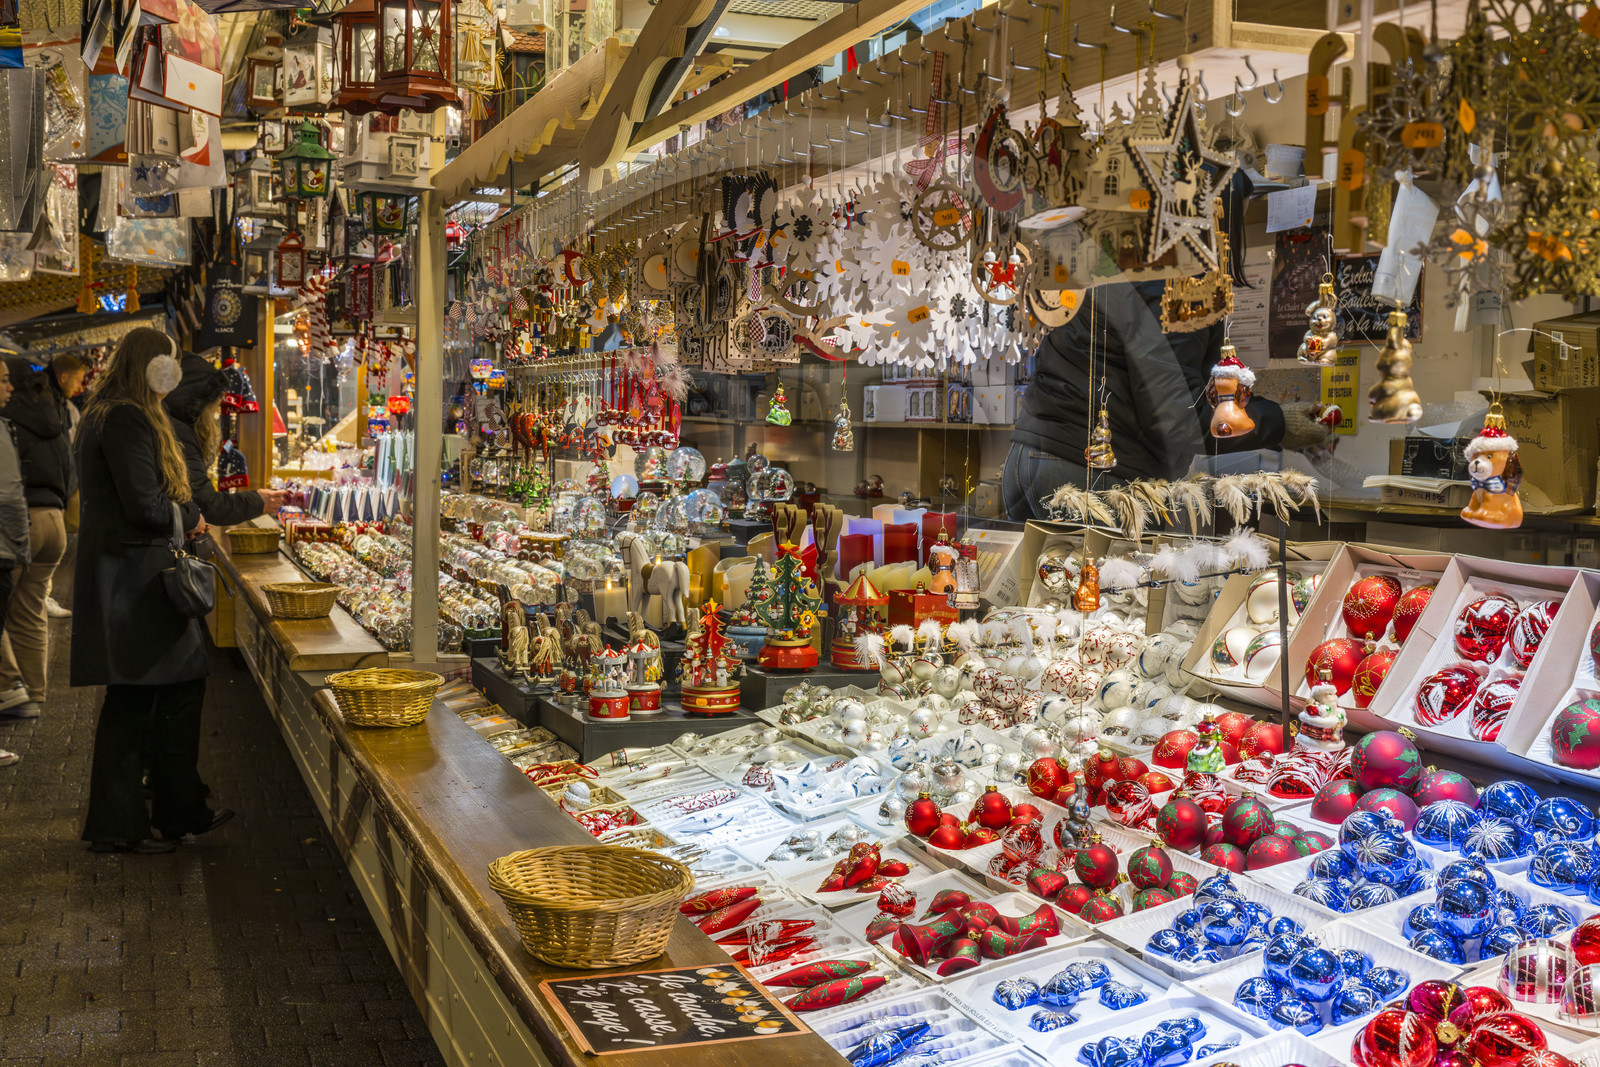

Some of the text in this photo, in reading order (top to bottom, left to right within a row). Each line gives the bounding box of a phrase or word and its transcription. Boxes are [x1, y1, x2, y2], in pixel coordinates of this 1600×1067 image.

[219, 477, 244, 488] ALSACE
[556, 984, 609, 998] je
[637, 974, 737, 1038] Je touche,
[570, 1001, 630, 1034] paye
[599, 981, 677, 1037] je casse,
